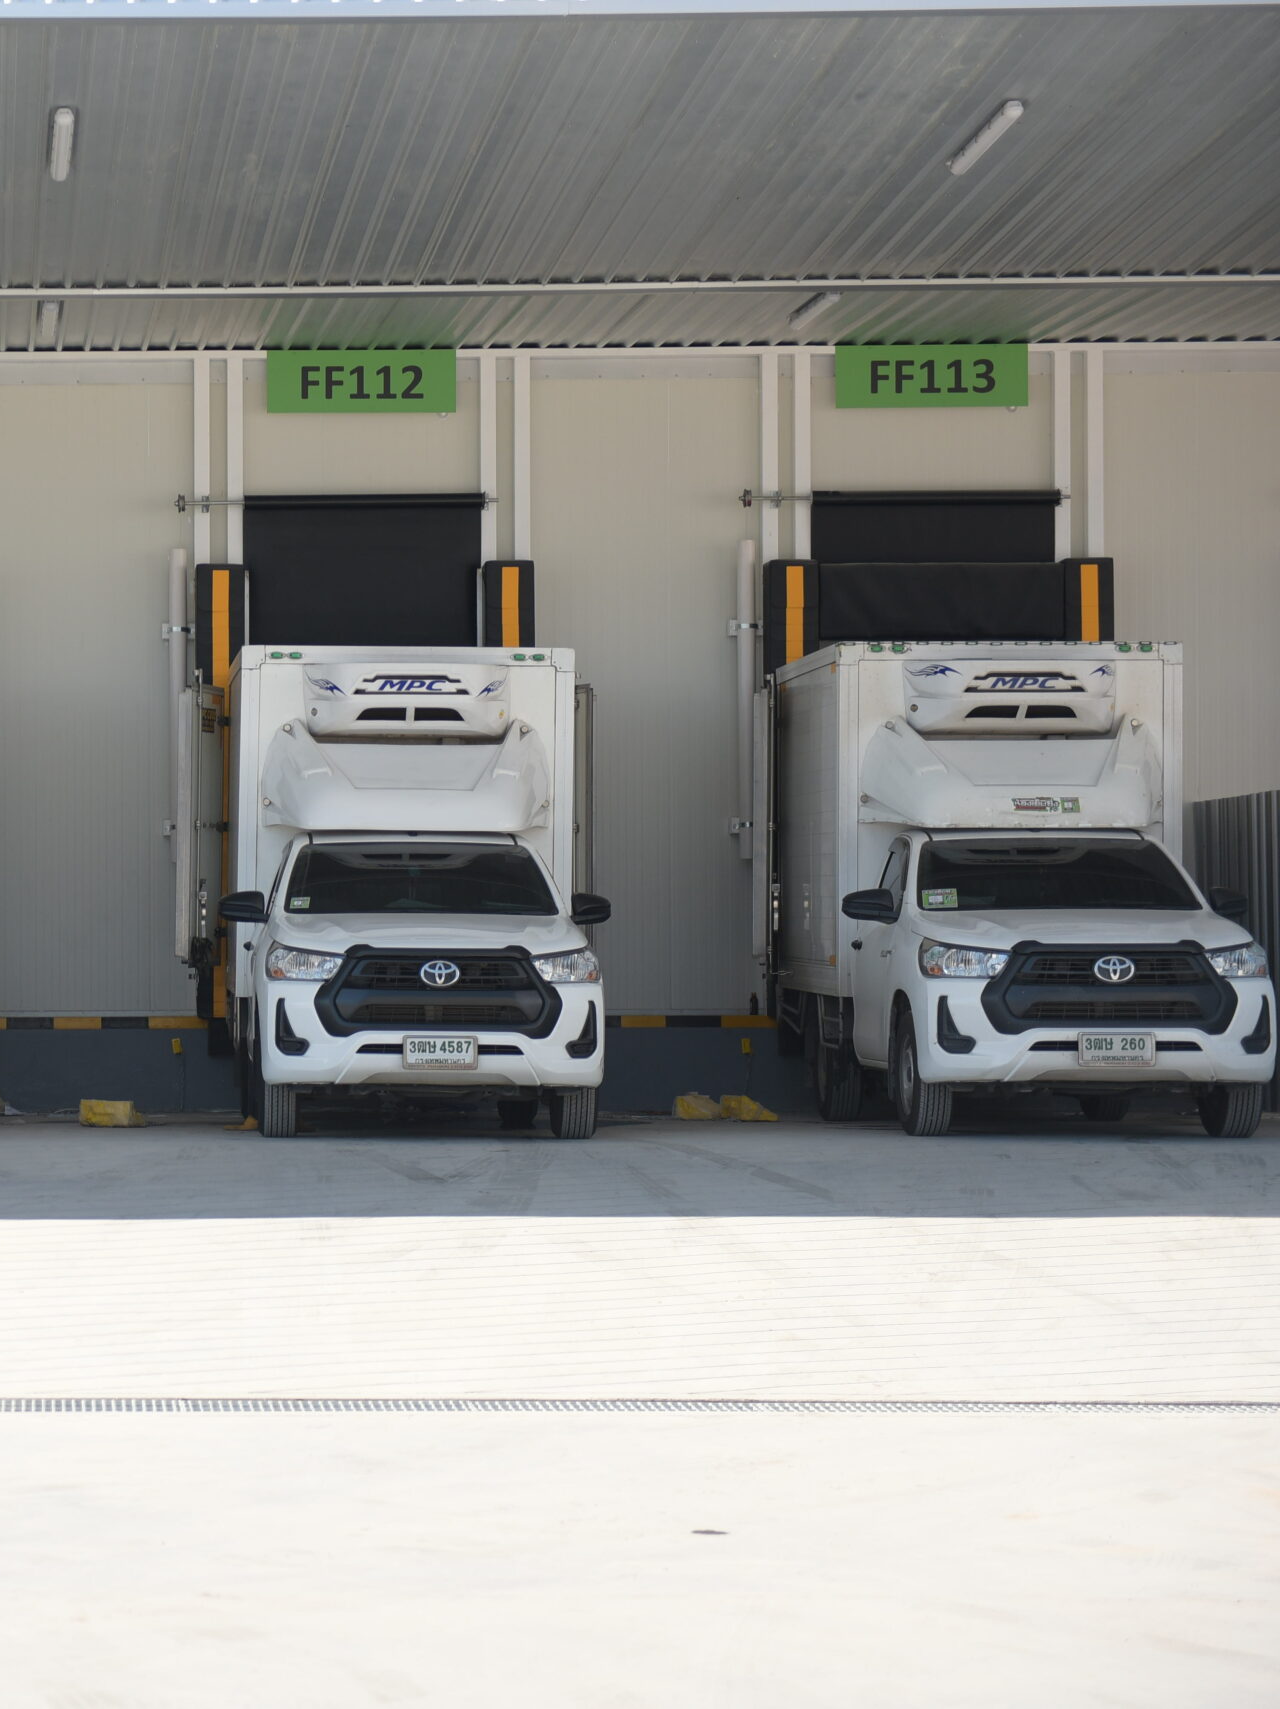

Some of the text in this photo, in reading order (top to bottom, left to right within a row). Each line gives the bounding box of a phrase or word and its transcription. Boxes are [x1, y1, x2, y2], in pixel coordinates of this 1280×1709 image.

[301, 365, 424, 400] FF112
[870, 358, 996, 394] FF113
[378, 679, 447, 692] MPC
[990, 676, 1059, 690] MPC
[439, 1041, 472, 1054] 4587
[1120, 1038, 1146, 1050] 260
